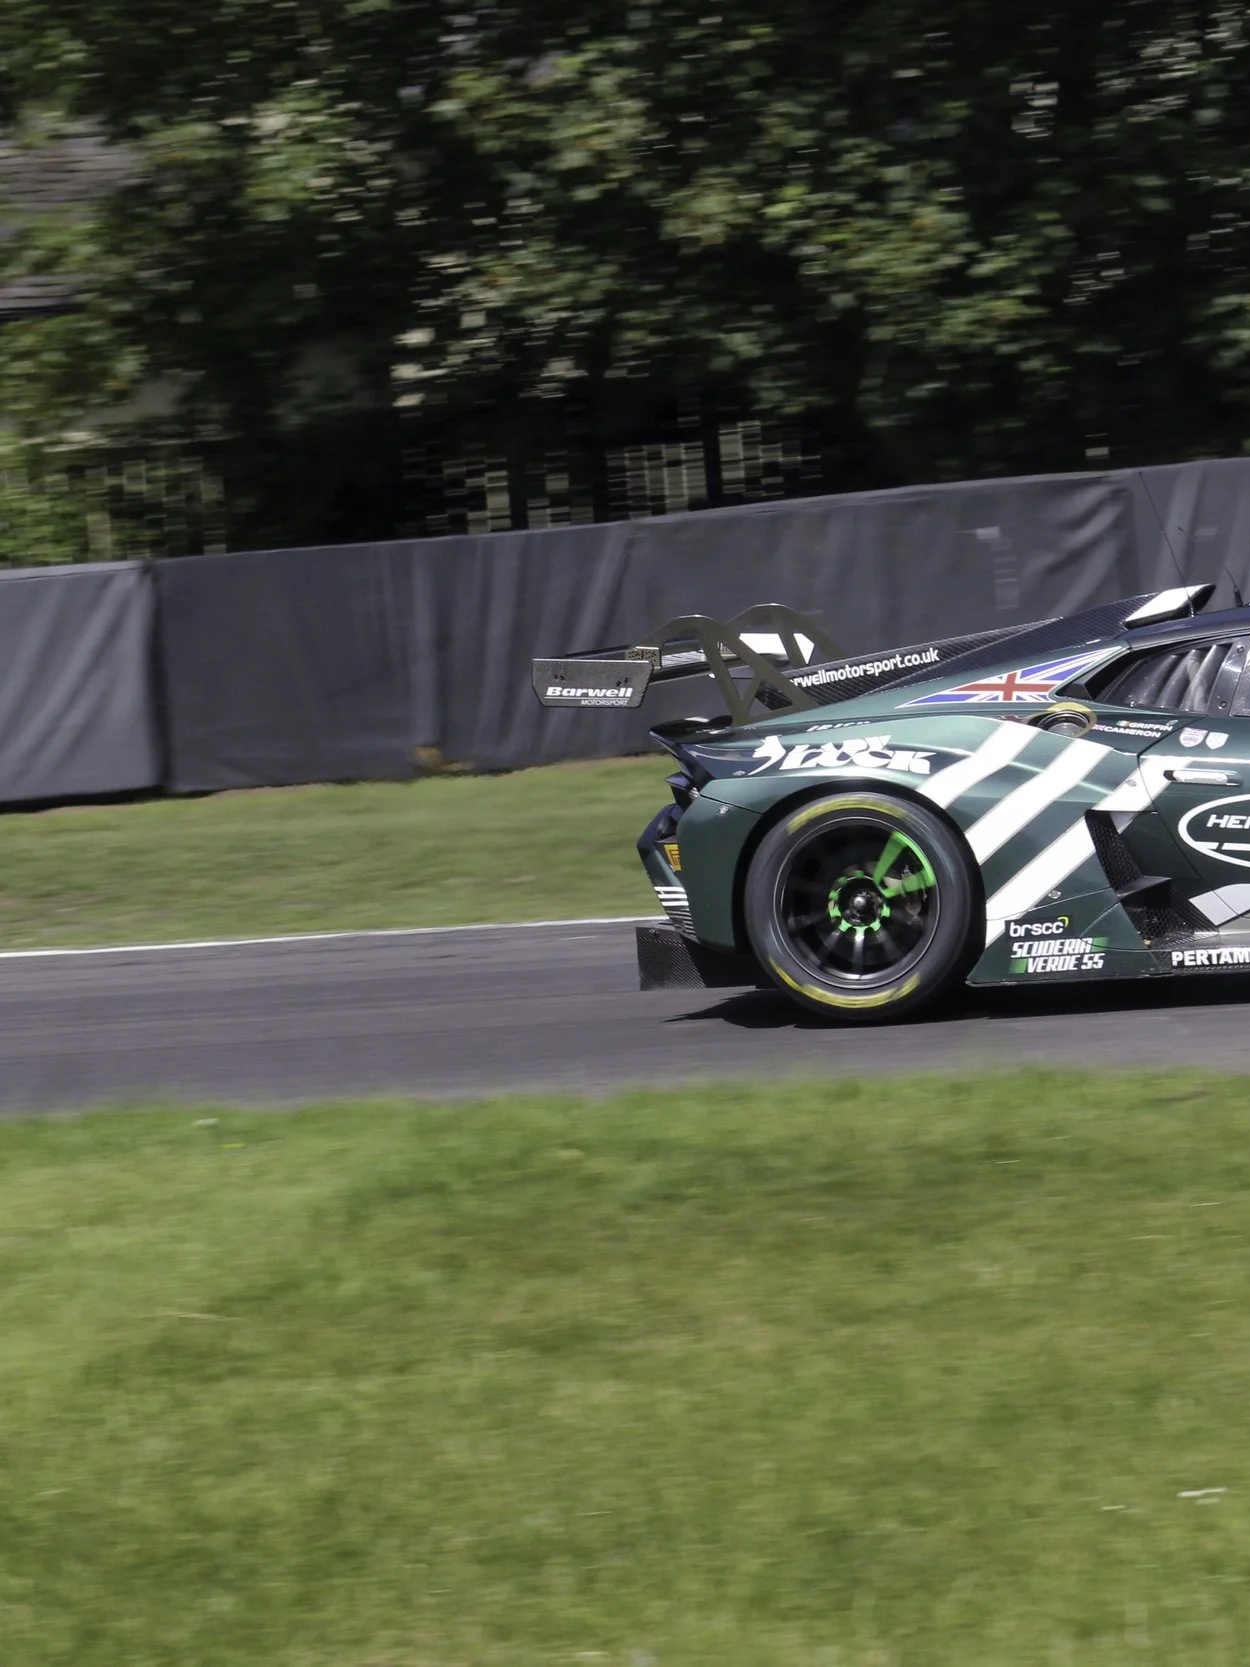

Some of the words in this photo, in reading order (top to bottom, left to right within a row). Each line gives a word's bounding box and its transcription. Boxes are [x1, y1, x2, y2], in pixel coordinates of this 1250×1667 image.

[789, 647, 940, 688] rwellmotorsport.co.uk
[546, 686, 634, 698] Barwell
[581, 699, 628, 707] MOTORSPORT
[1103, 725, 1162, 738] CAMERON
[1129, 721, 1174, 732] GRIFFIN
[1009, 921, 1064, 937] brscc
[1010, 937, 1094, 958] SCUDERIA
[1027, 954, 1081, 974] VERDE
[1081, 952, 1106, 970] 55
